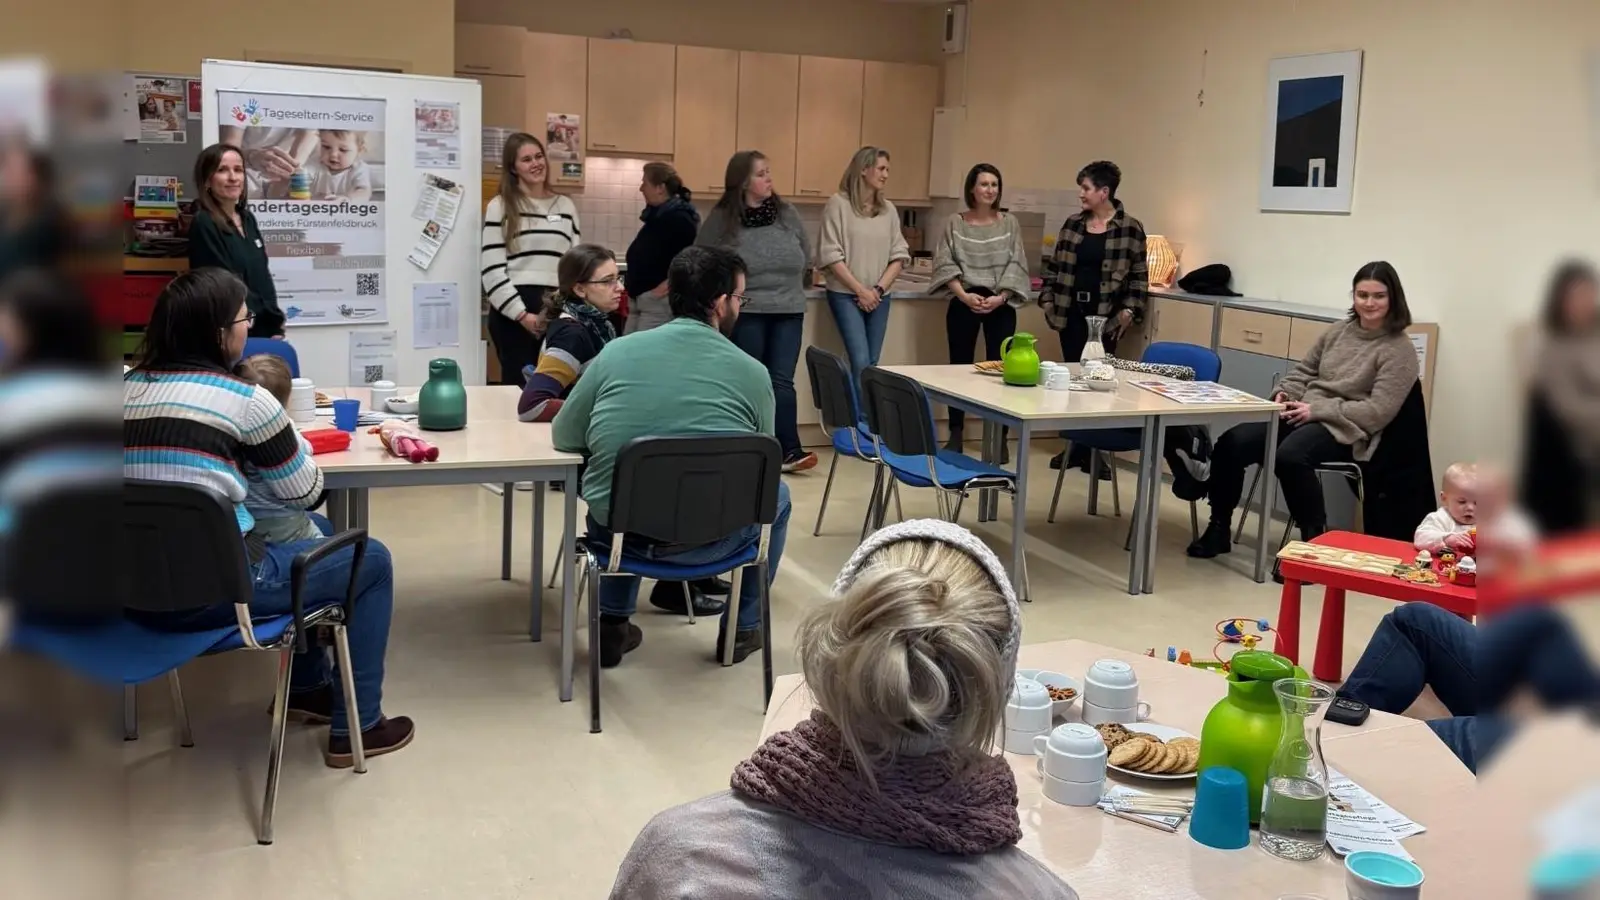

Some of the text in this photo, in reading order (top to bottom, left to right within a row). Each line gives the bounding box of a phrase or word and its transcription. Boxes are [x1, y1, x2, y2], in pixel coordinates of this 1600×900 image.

[262, 107, 374, 122] Tageseltern-Service
[246, 201, 378, 216] ndertagespflege
[296, 218, 378, 228] Fürstenfeldbruck
[264, 232, 299, 242] ennah
